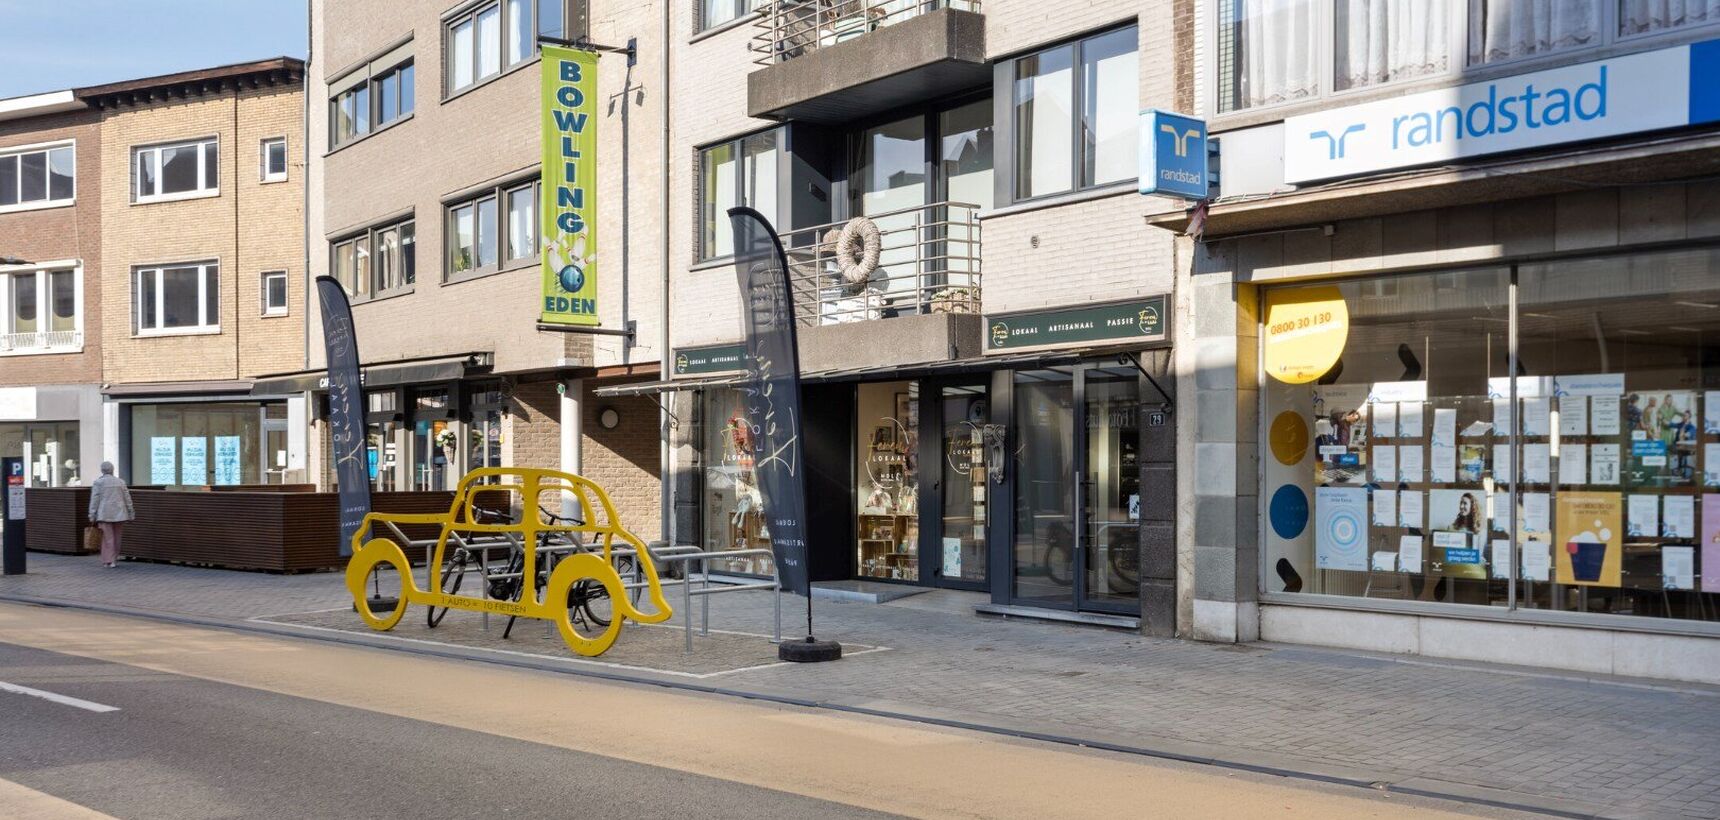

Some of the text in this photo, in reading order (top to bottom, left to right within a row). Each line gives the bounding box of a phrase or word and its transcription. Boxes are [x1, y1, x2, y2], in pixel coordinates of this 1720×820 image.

[1392, 65, 1607, 149] randstad
[552, 60, 588, 233] BOWLING
[1160, 169, 1201, 185] randstad
[545, 296, 595, 314] EDEN
[1012, 317, 1134, 336] LOKAAL ARTISANAAL PASSIE
[1270, 321, 1295, 335] 0800
[1297, 317, 1310, 329] 30
[1152, 415, 1162, 425] 29
[12, 462, 22, 475] P
[447, 598, 470, 608] AUTO
[484, 600, 493, 610] 10
[495, 602, 527, 613] FIETSEN
